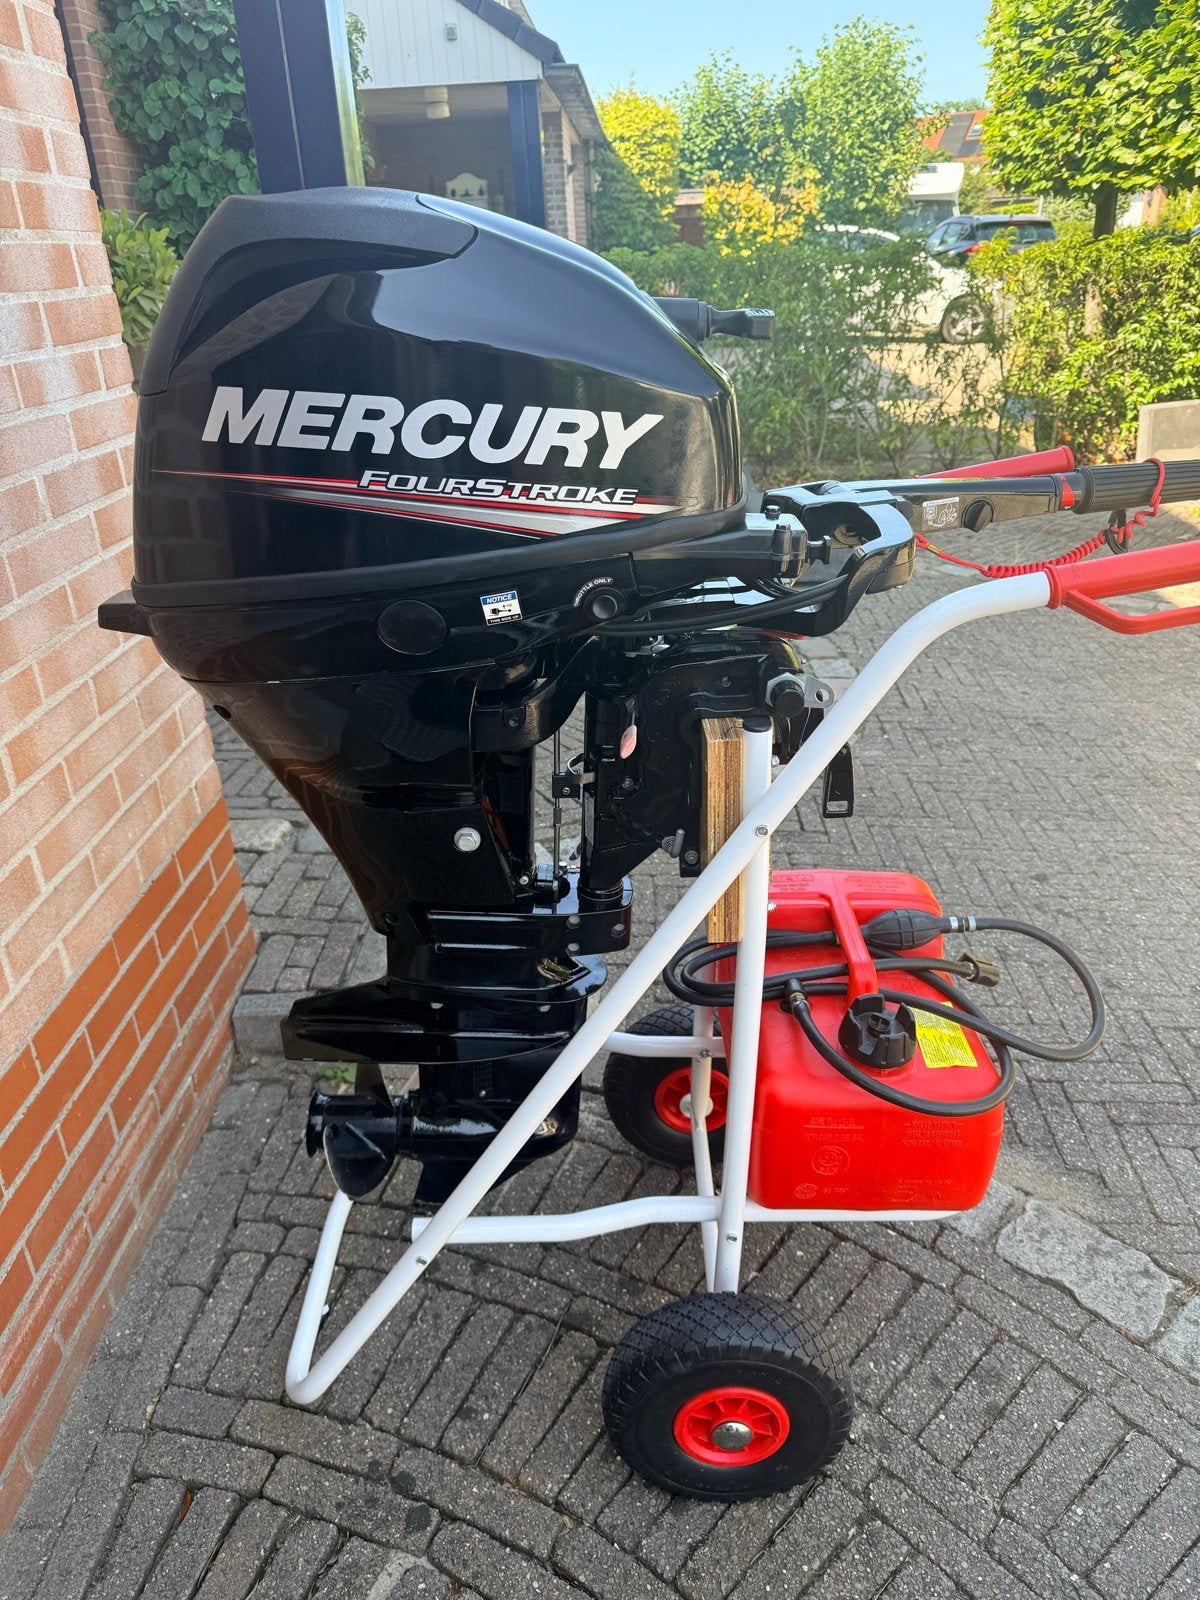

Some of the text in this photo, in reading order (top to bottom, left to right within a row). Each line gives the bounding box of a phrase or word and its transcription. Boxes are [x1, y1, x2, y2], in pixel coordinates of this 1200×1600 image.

[201, 385, 665, 470] MERCURY
[593, 577, 612, 585] ONLY
[486, 593, 513, 604] NOTICE
